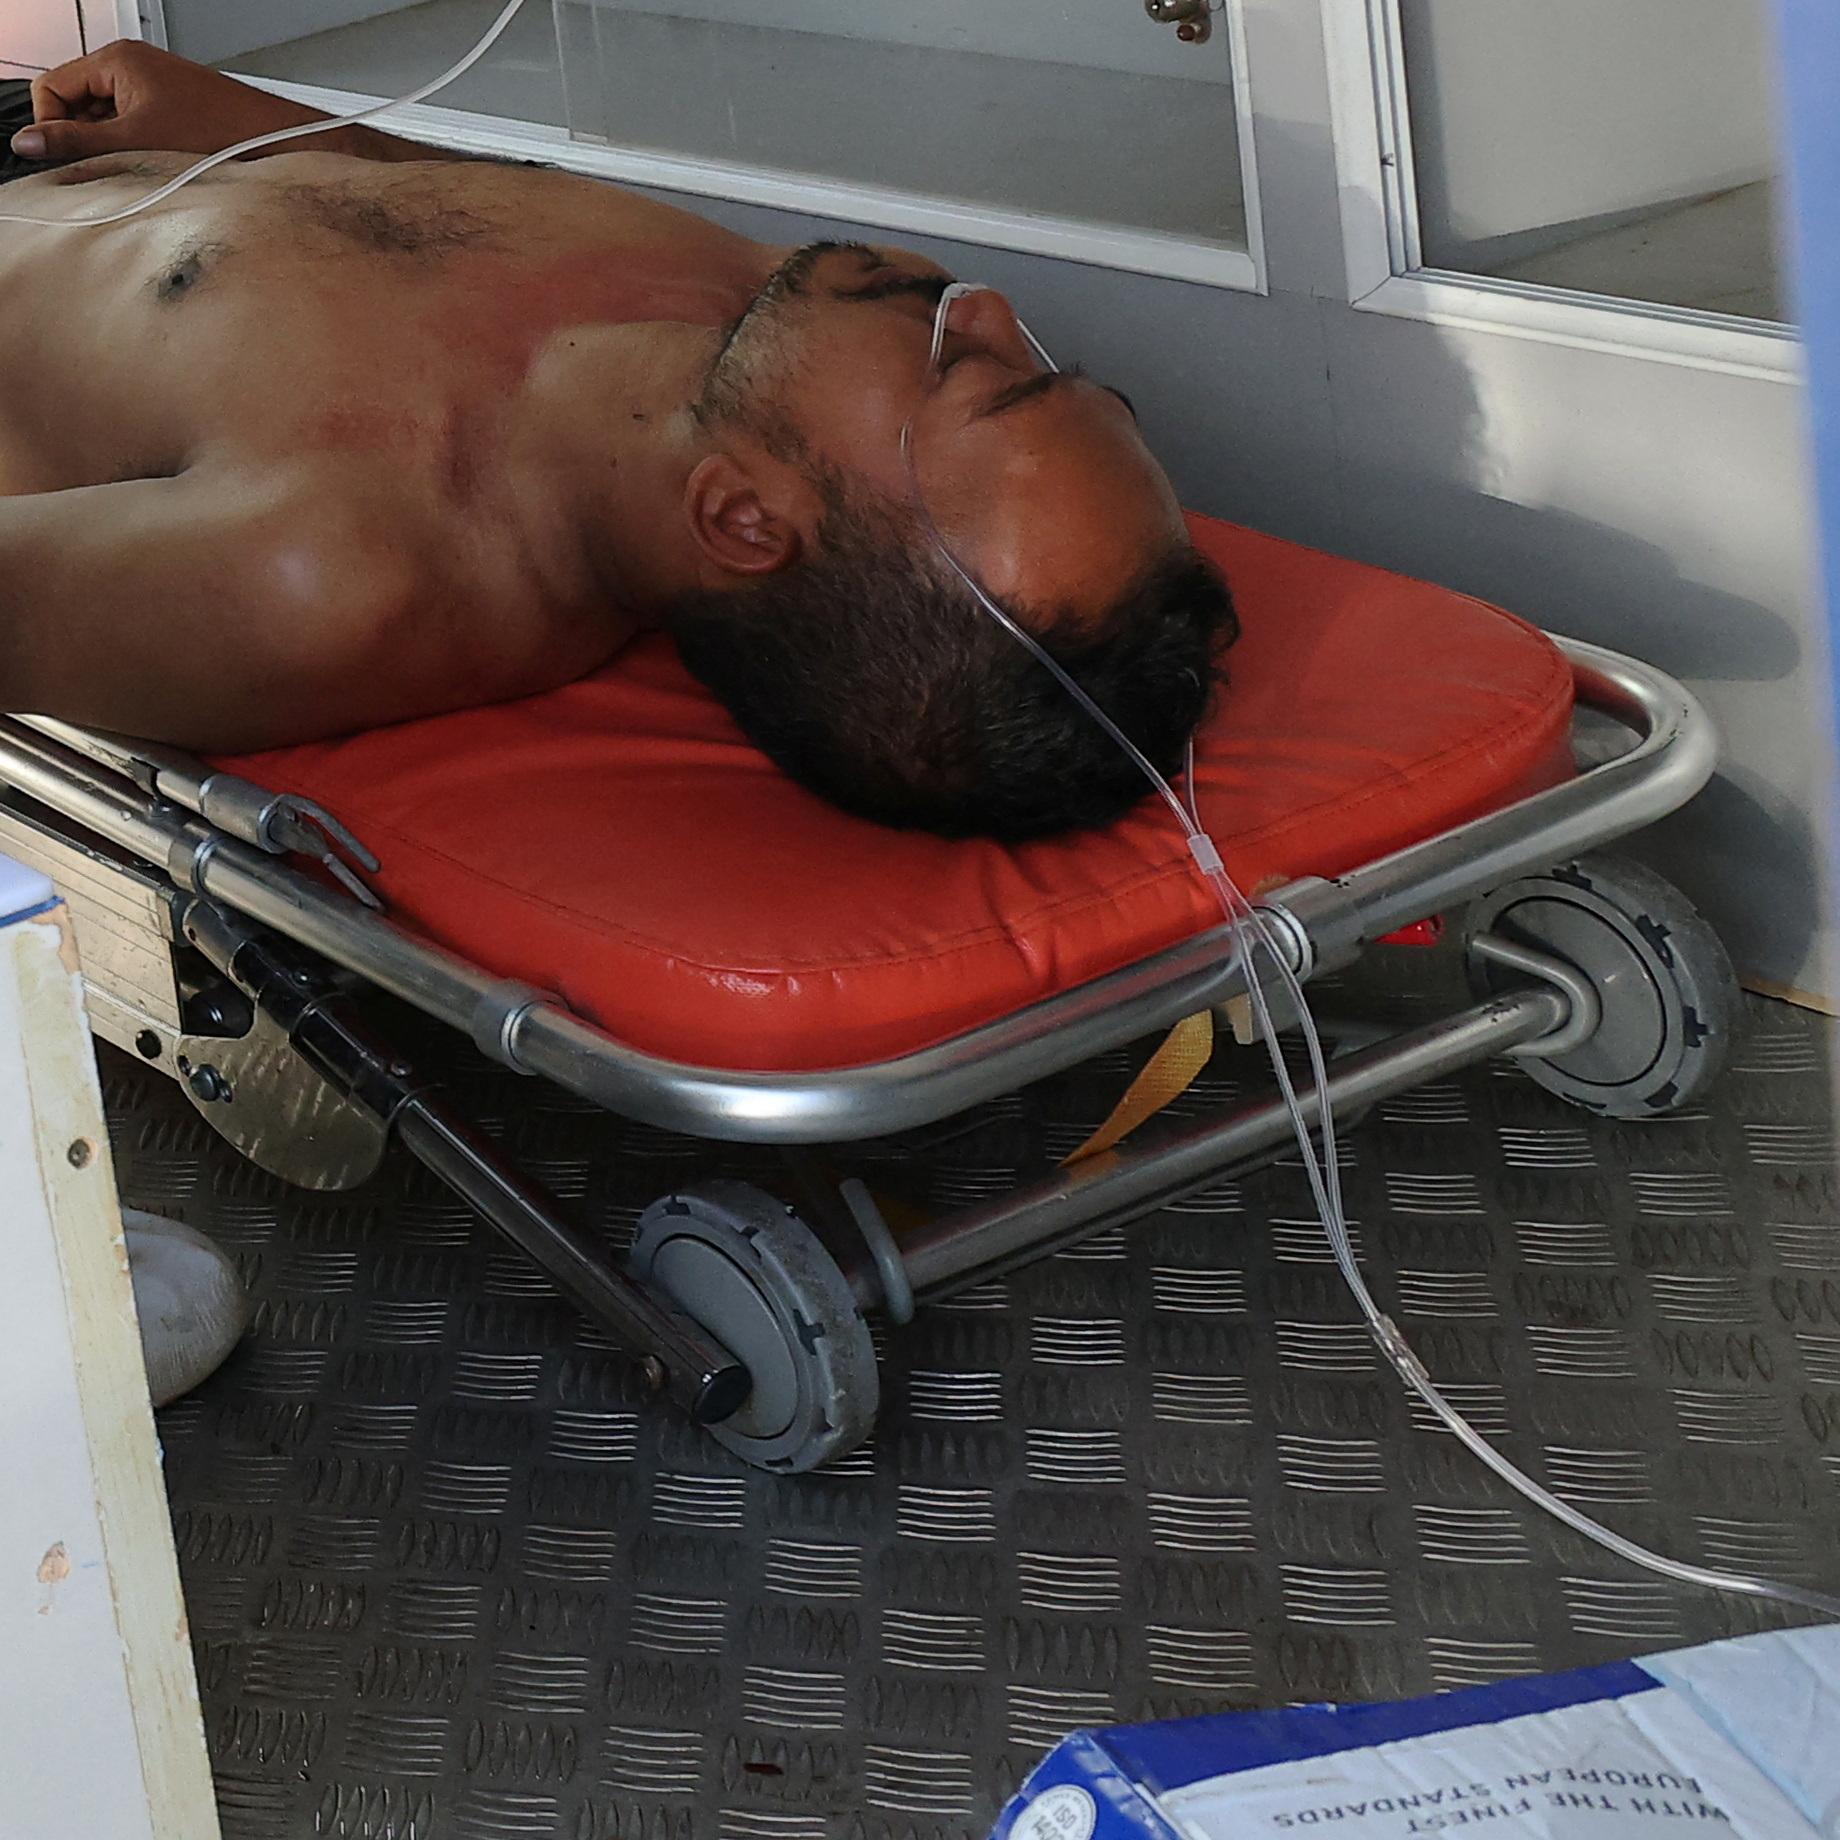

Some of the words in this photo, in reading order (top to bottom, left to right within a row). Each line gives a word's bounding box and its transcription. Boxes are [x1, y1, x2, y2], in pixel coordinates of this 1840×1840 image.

[1505, 1769, 1703, 1795] EUROPEAN
[1272, 1782, 1492, 1828] STANDARDS
[1546, 1791, 1620, 1811] THE
[1631, 1796, 1731, 1823] WITH
[1053, 1803, 1077, 1829] ISO
[1406, 1798, 1531, 1834] FINEST
